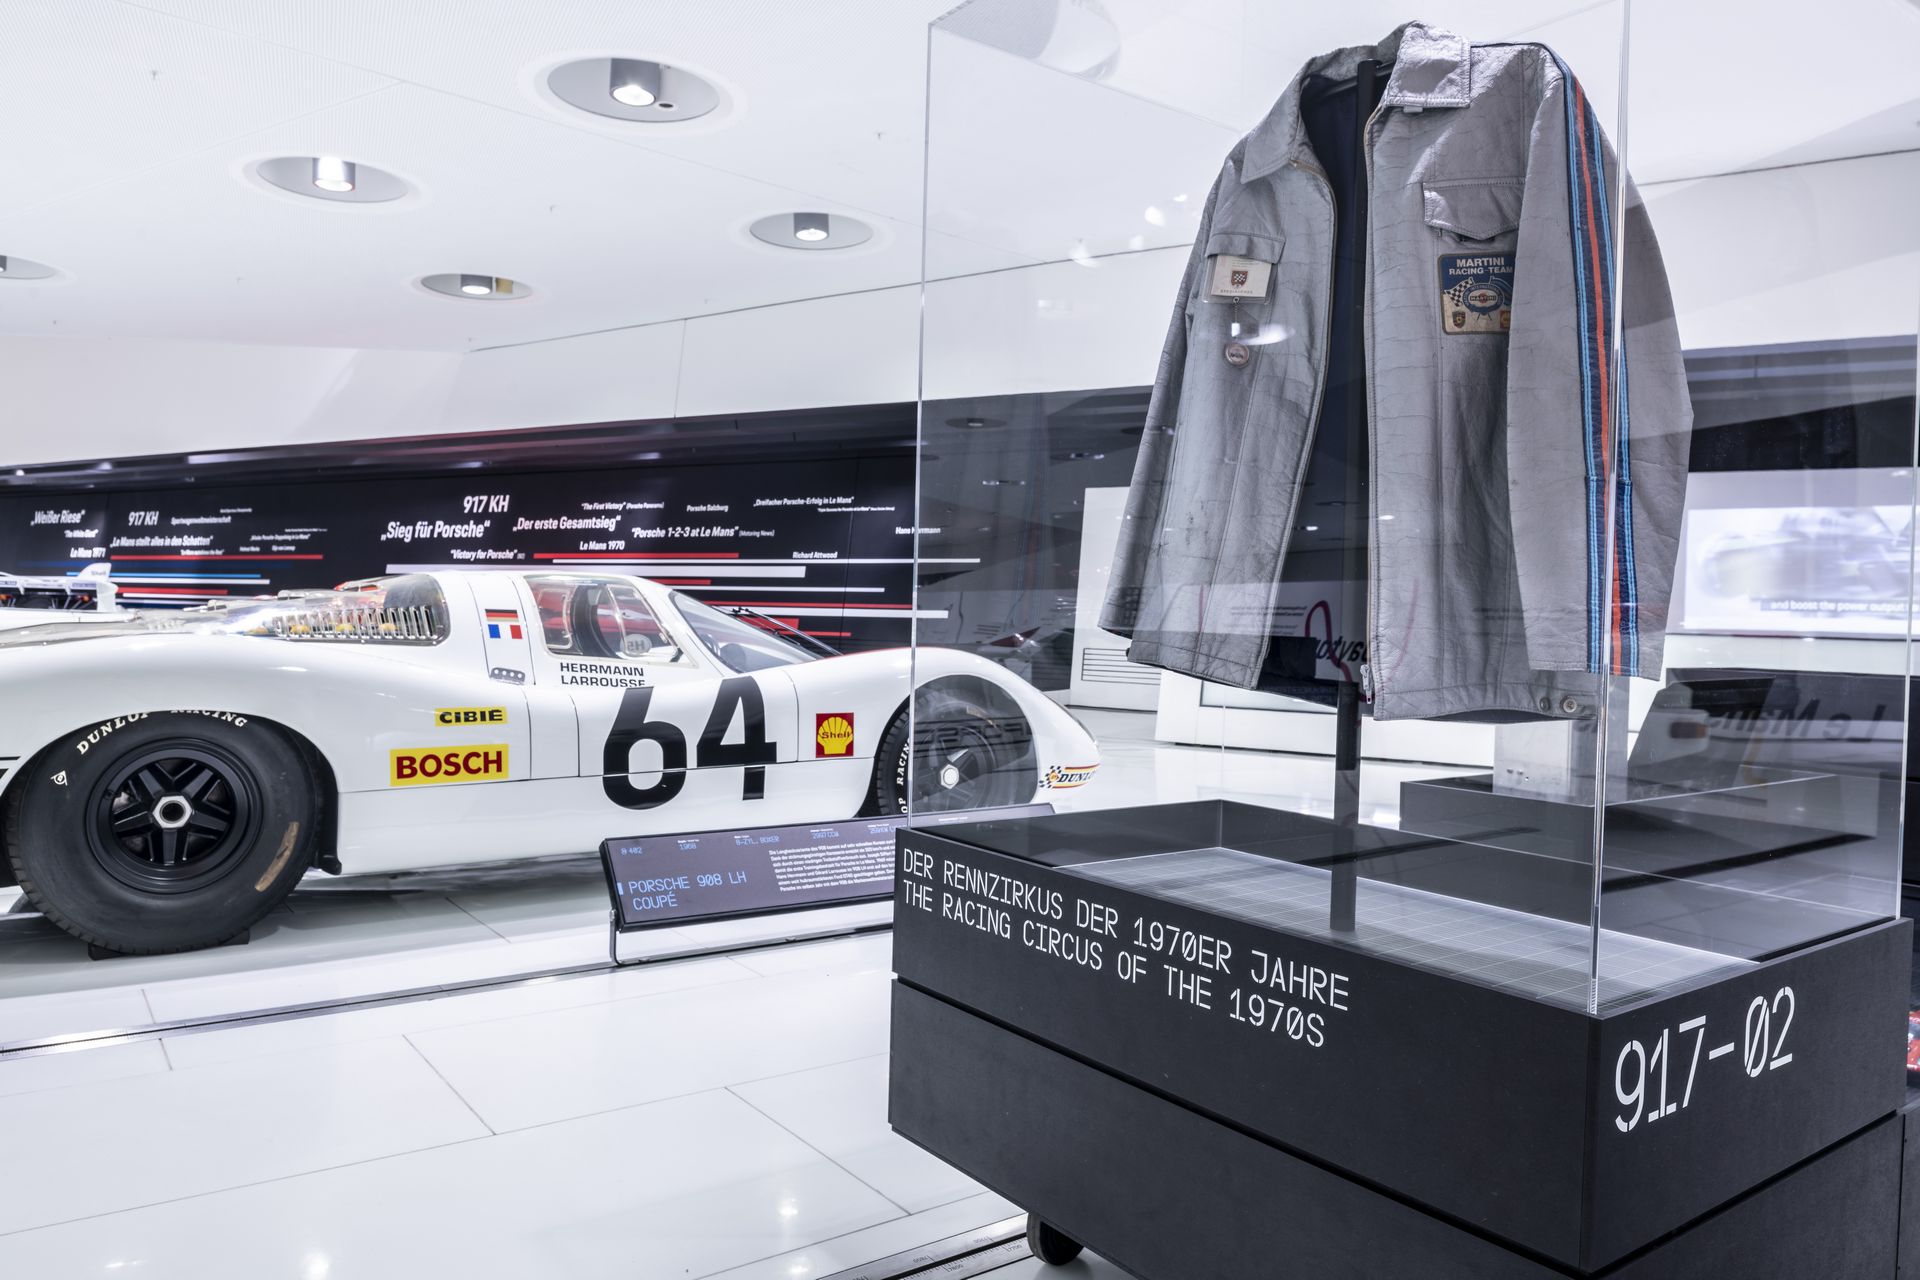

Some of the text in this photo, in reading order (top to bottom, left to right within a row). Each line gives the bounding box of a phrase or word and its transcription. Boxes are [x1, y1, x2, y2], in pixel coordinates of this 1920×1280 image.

[1456, 257, 1504, 268] MARTINI
[462, 494, 509, 513] 917 KH
[128, 510, 159, 526] 917 KH
[534, 517, 558, 530] erste
[414, 520, 434, 538] für
[667, 526, 689, 538] 1-2-3
[690, 528, 699, 537] at
[700, 526, 711, 537] Le
[579, 540, 626, 551] Le Mans 1970
[476, 549, 487, 559] for
[792, 551, 814, 559] Richard
[560, 662, 644, 677] HERRMANN
[602, 676, 777, 810] 64
[822, 731, 850, 739] Shell
[396, 751, 502, 779] BOSCH
[628, 870, 747, 894] PORSCHE 908 LH
[632, 890, 678, 911] COUPÉ
[903, 847, 1349, 1011] DER RENNZIRKUS DER 1970ER JAHRE
[903, 879, 1325, 1048] THE RACING CIRCUS OF THE 1970S
